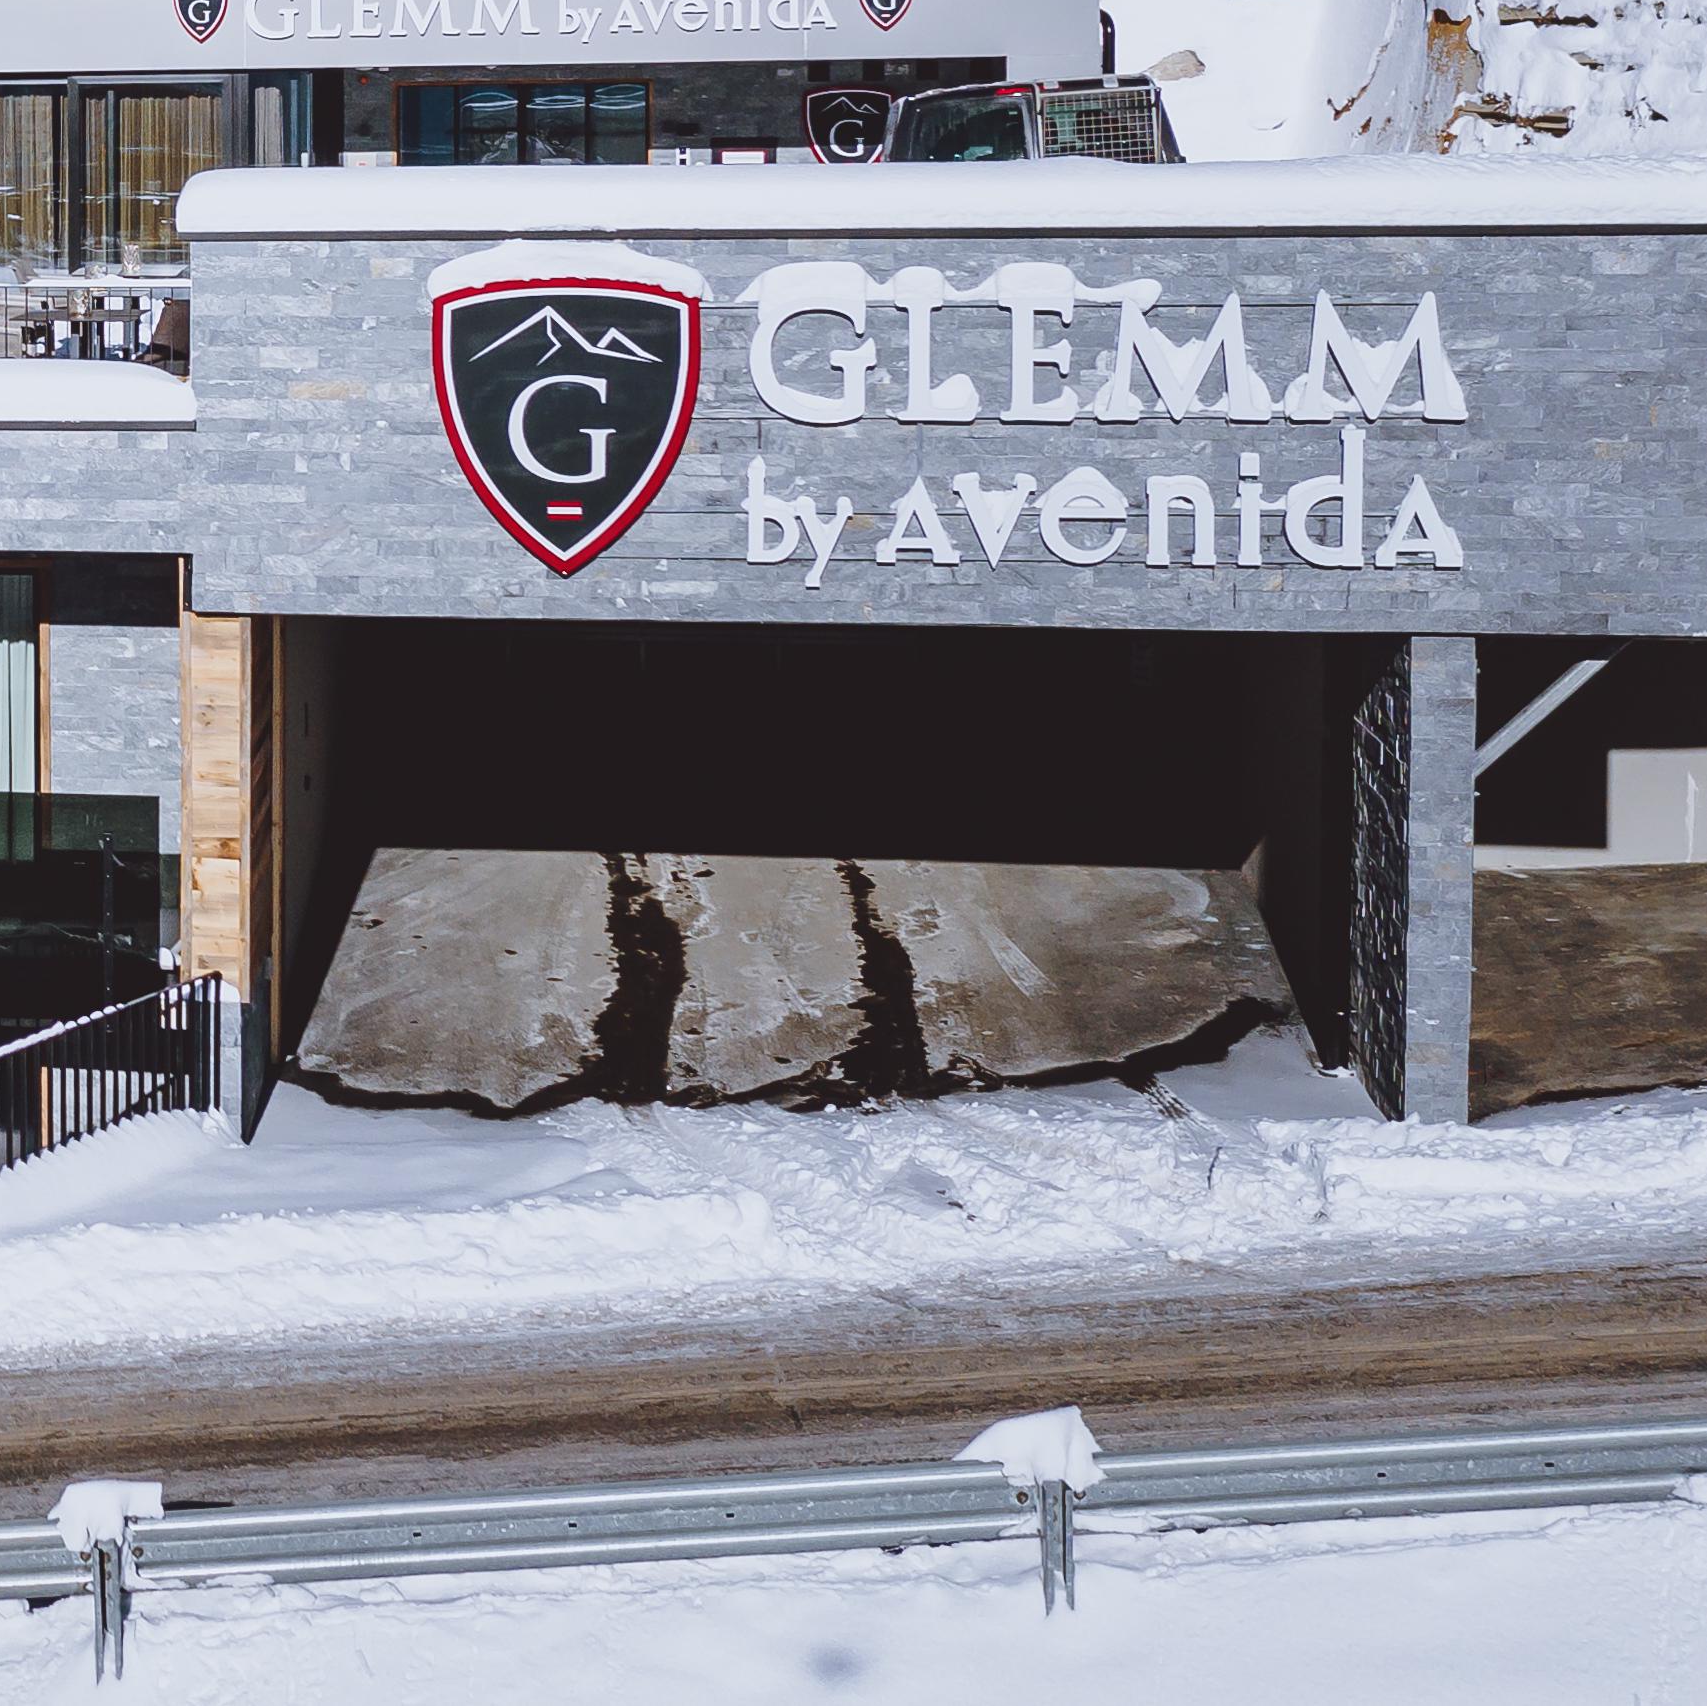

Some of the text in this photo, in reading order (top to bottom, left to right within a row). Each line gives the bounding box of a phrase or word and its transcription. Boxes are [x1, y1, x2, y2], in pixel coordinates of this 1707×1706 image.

[188, 0, 212, 25] G
[828, 119, 866, 158] G
[749, 286, 1470, 426] GLEMM
[507, 374, 617, 484] G
[745, 455, 854, 590] by
